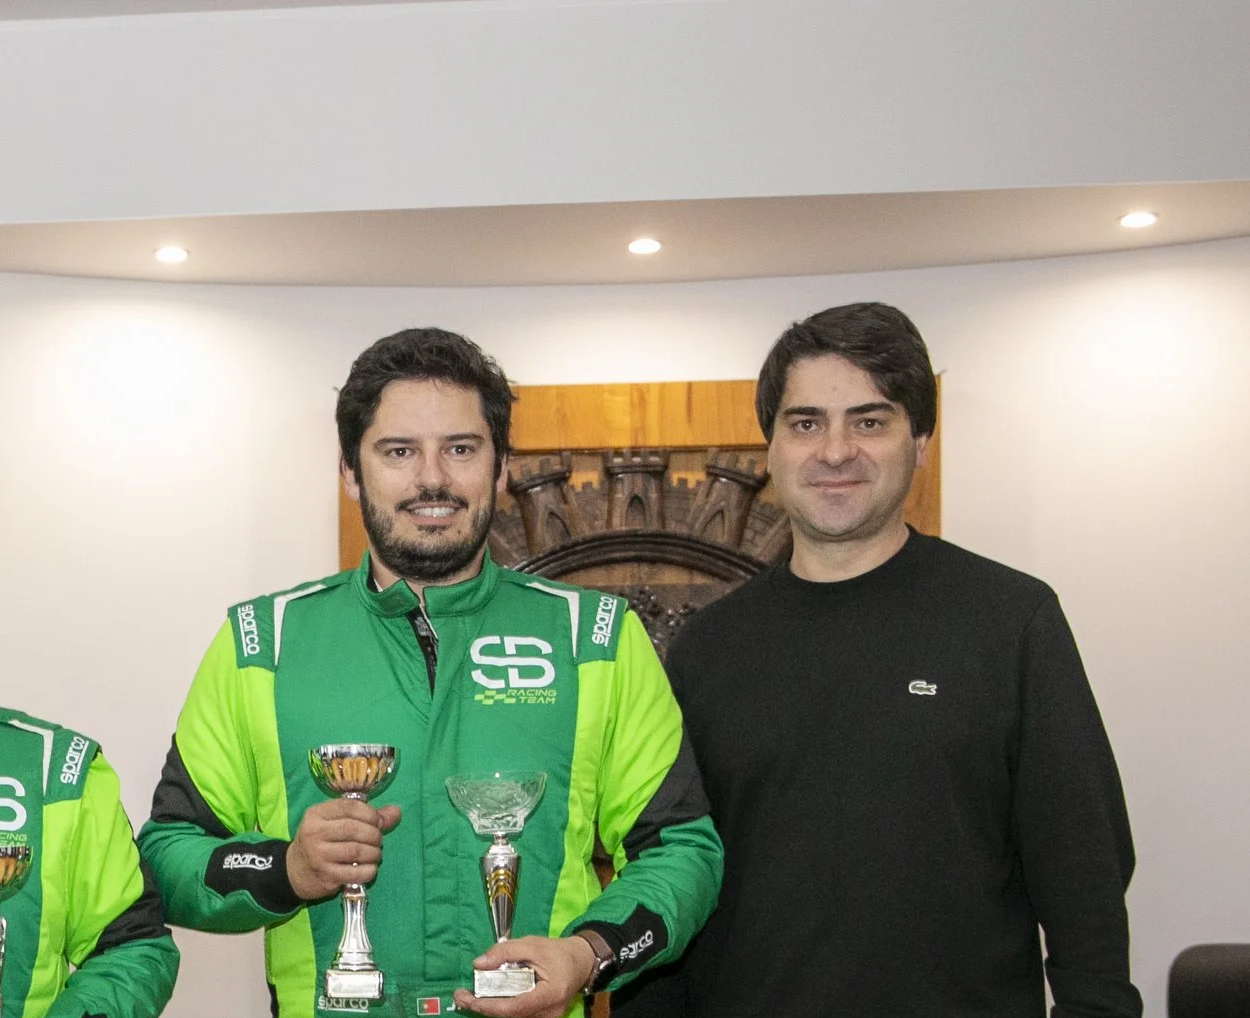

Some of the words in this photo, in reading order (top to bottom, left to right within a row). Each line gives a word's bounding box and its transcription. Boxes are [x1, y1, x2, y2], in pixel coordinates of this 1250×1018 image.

[237, 604, 260, 657] sparco
[592, 597, 618, 647] sparco
[507, 689, 557, 697] RACING
[519, 696, 556, 704] TEAM
[60, 736, 89, 785] sparco
